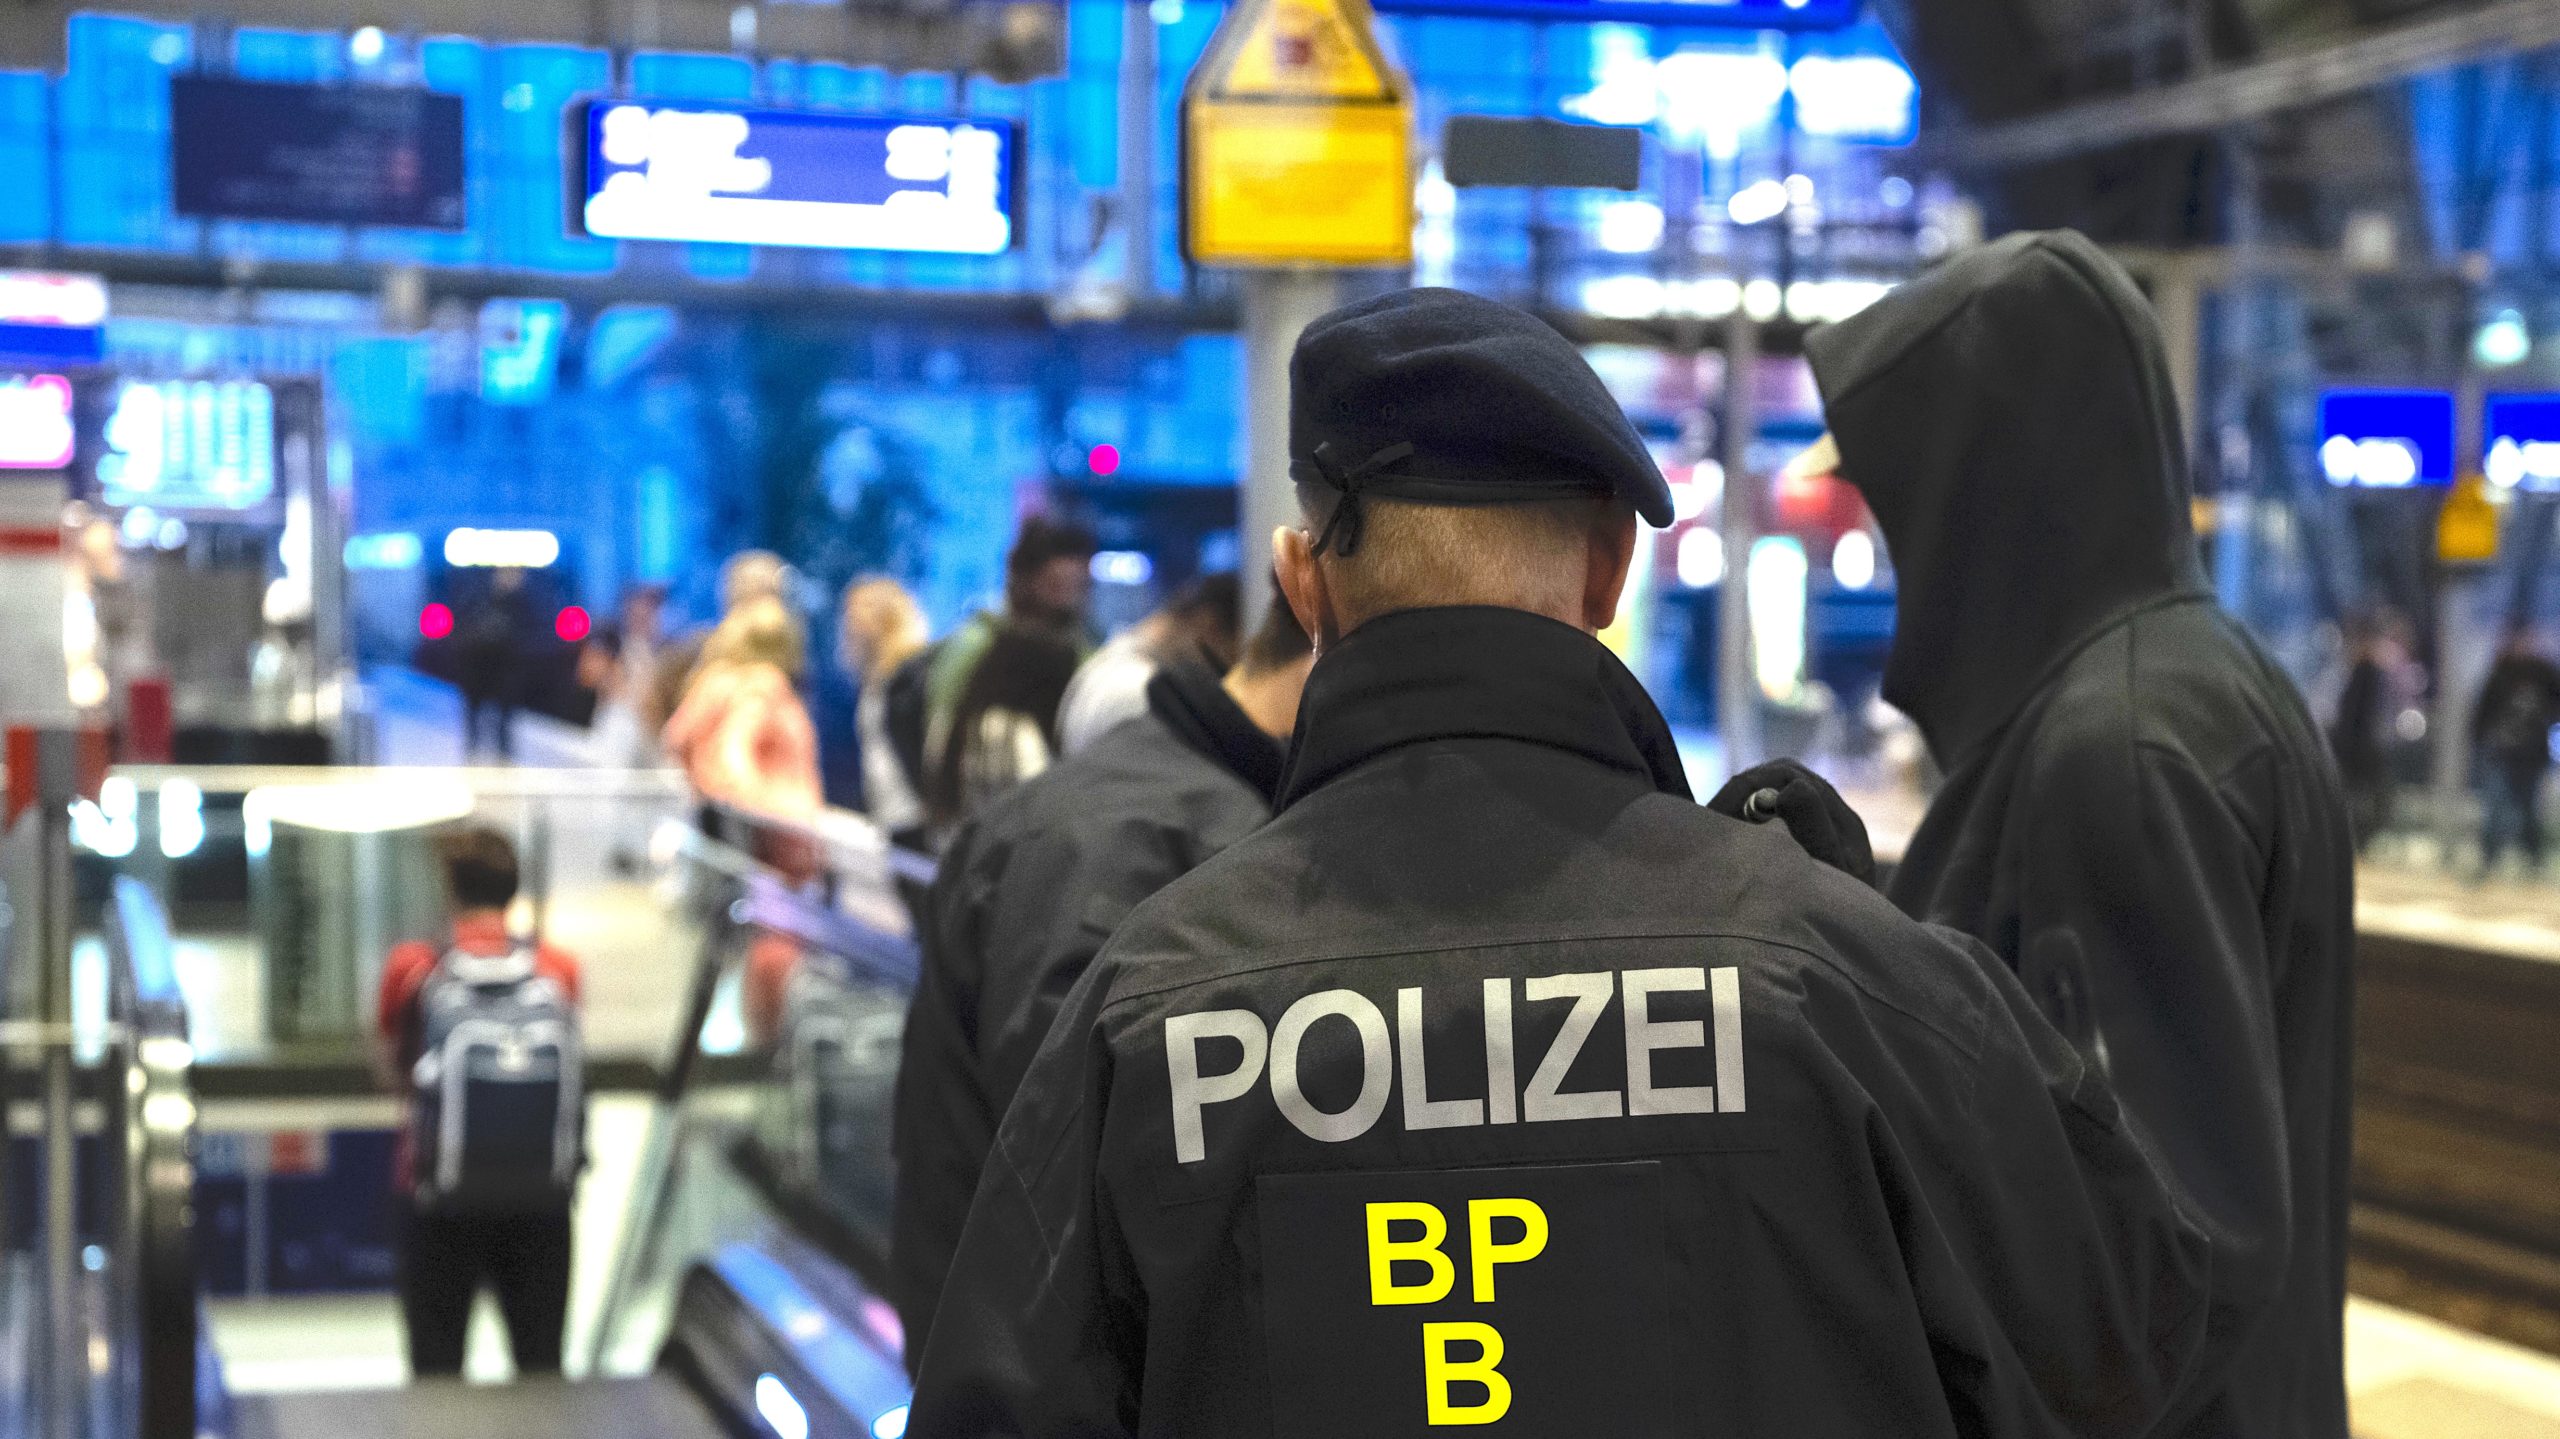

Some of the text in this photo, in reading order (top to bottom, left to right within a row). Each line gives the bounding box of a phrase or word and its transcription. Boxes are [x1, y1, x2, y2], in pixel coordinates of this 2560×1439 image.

[1165, 966, 1746, 1163] POLIZEI
[1366, 1198, 1549, 1306] BP
[1424, 1322, 1512, 1426] B
